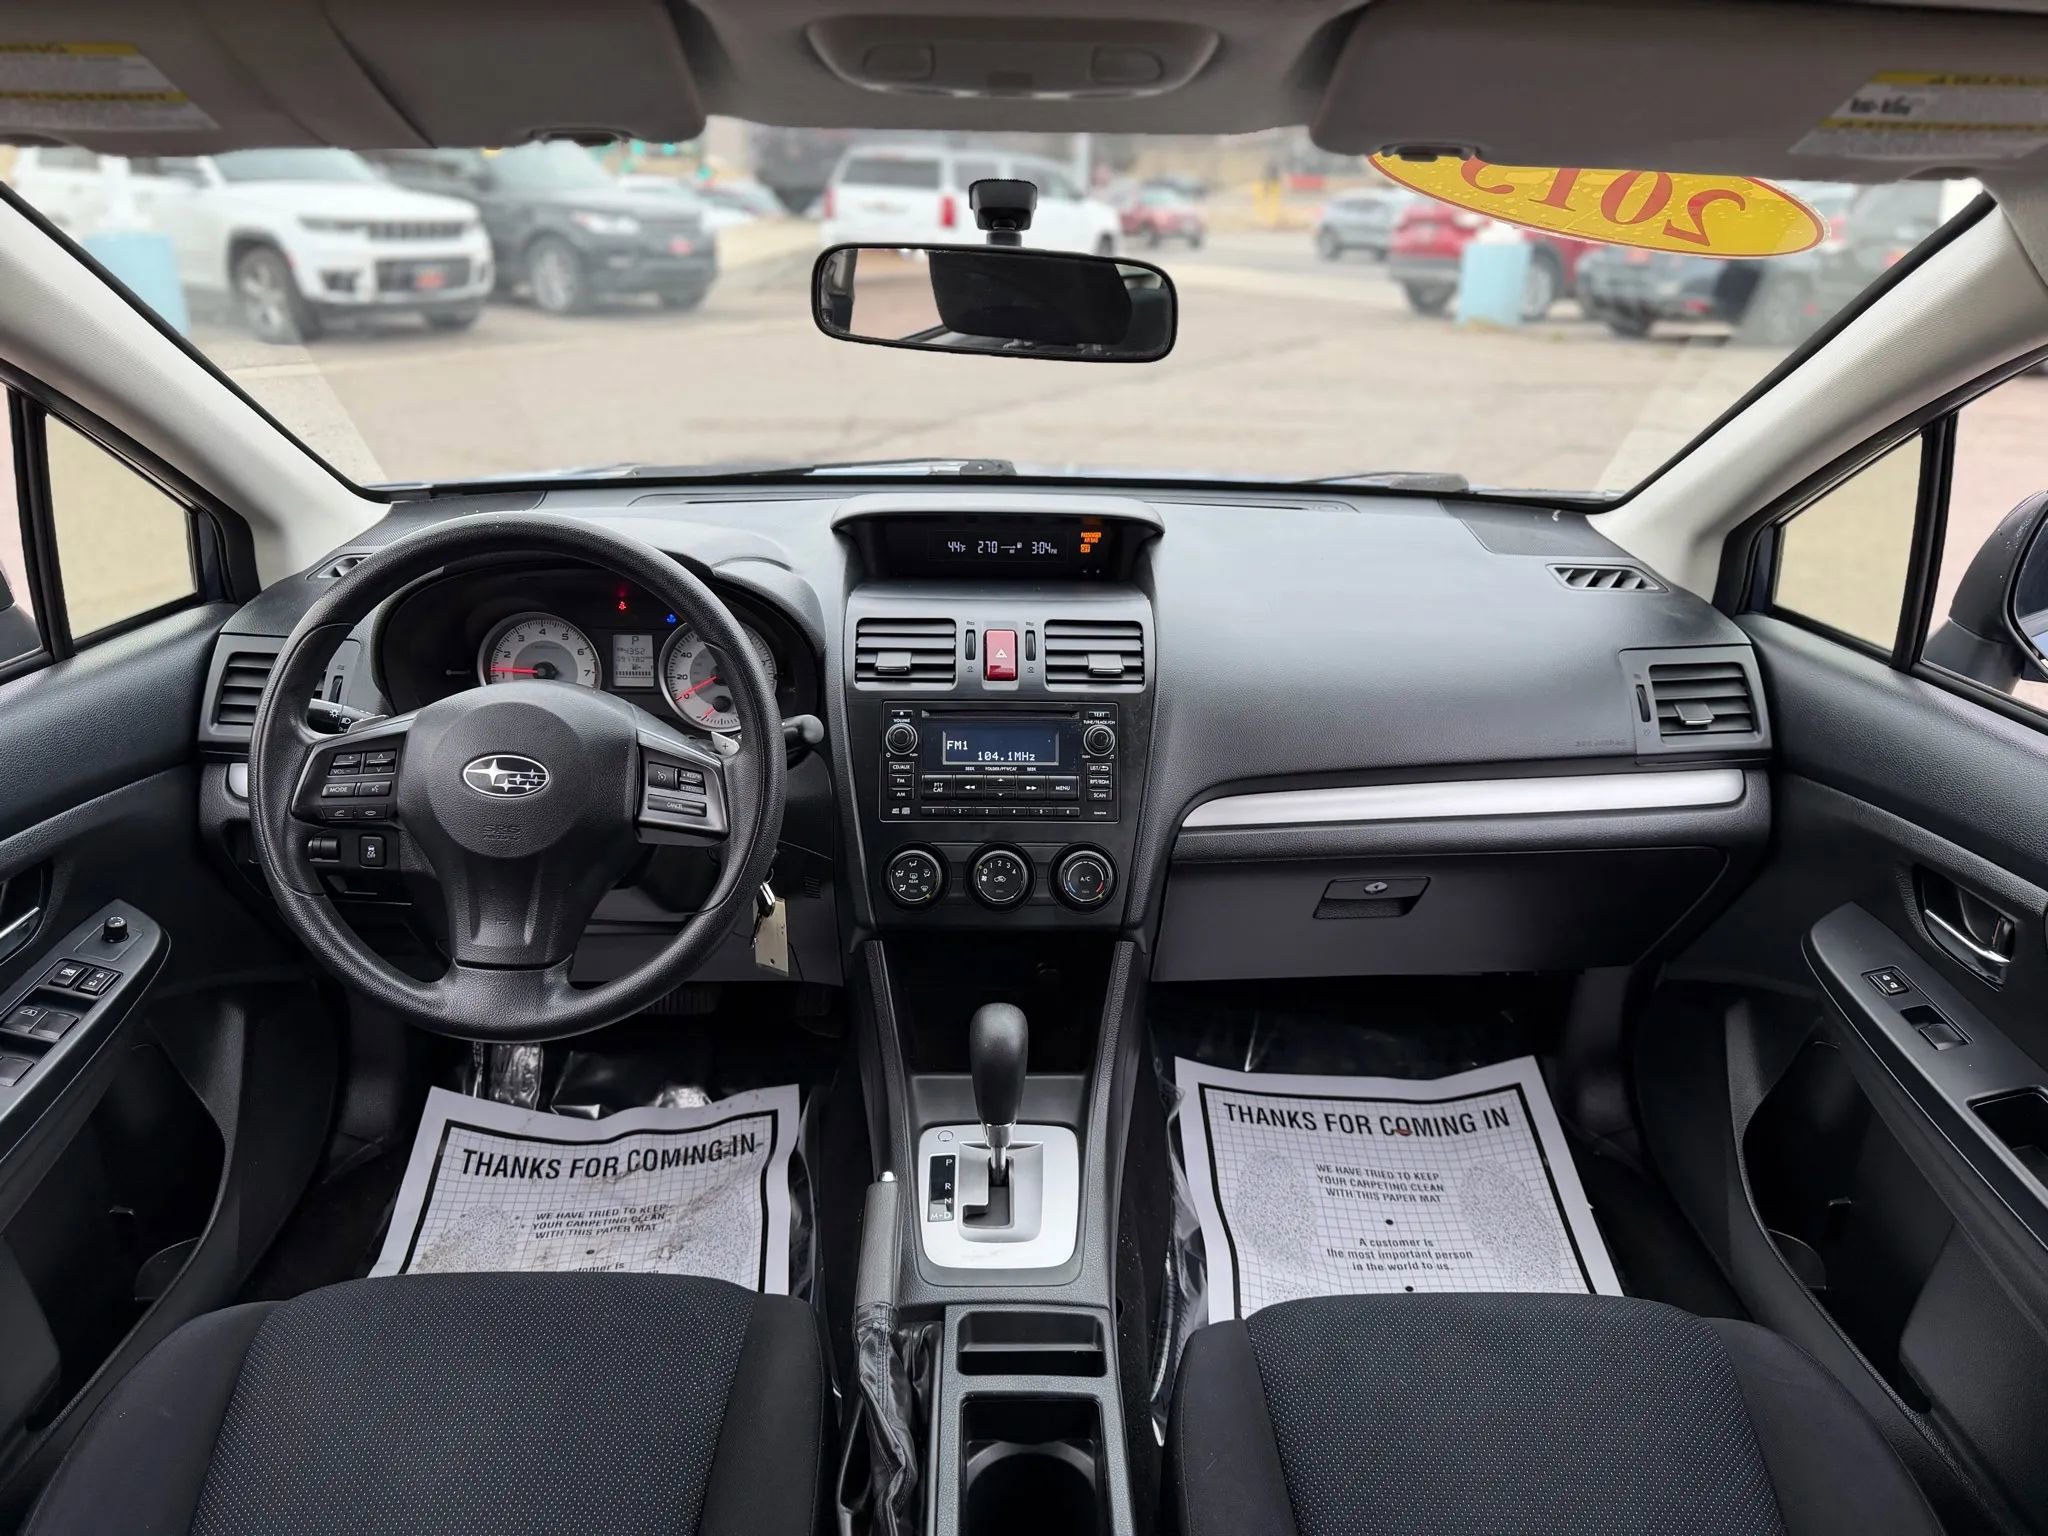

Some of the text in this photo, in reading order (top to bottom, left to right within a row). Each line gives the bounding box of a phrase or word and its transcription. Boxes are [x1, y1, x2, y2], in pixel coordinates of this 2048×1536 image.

[977, 541, 998, 553] 270
[1031, 541, 1051, 554] 3:04
[631, 636, 639, 645] P
[946, 740, 968, 750] FM1
[977, 751, 1036, 761] 104.1MHz
[1223, 1102, 1510, 1137] THANKS FOR COMING IN
[463, 1132, 755, 1179] THANKS FOR COMING IN
[1316, 1164, 1439, 1180] WE HAVE TRIED TO KEEP
[944, 1182, 951, 1190] R
[1317, 1175, 1444, 1192] YOUR CARPETING CLEAN
[1325, 1187, 1441, 1203] WITH THIS PAPER MAT
[556, 1211, 585, 1219] HAVE
[588, 1209, 619, 1218] TRIED
[623, 1206, 637, 1214] TO
[639, 1204, 667, 1213] KEEP
[533, 1213, 665, 1230] YOUR CARPETING CLEAN
[535, 1223, 657, 1239] WITH THIS PAPER MAT
[1359, 1238, 1367, 1247] A
[1370, 1238, 1420, 1247] customer
[1327, 1248, 1473, 1261] the most important person
[1352, 1262, 1454, 1271] in the world to us.
